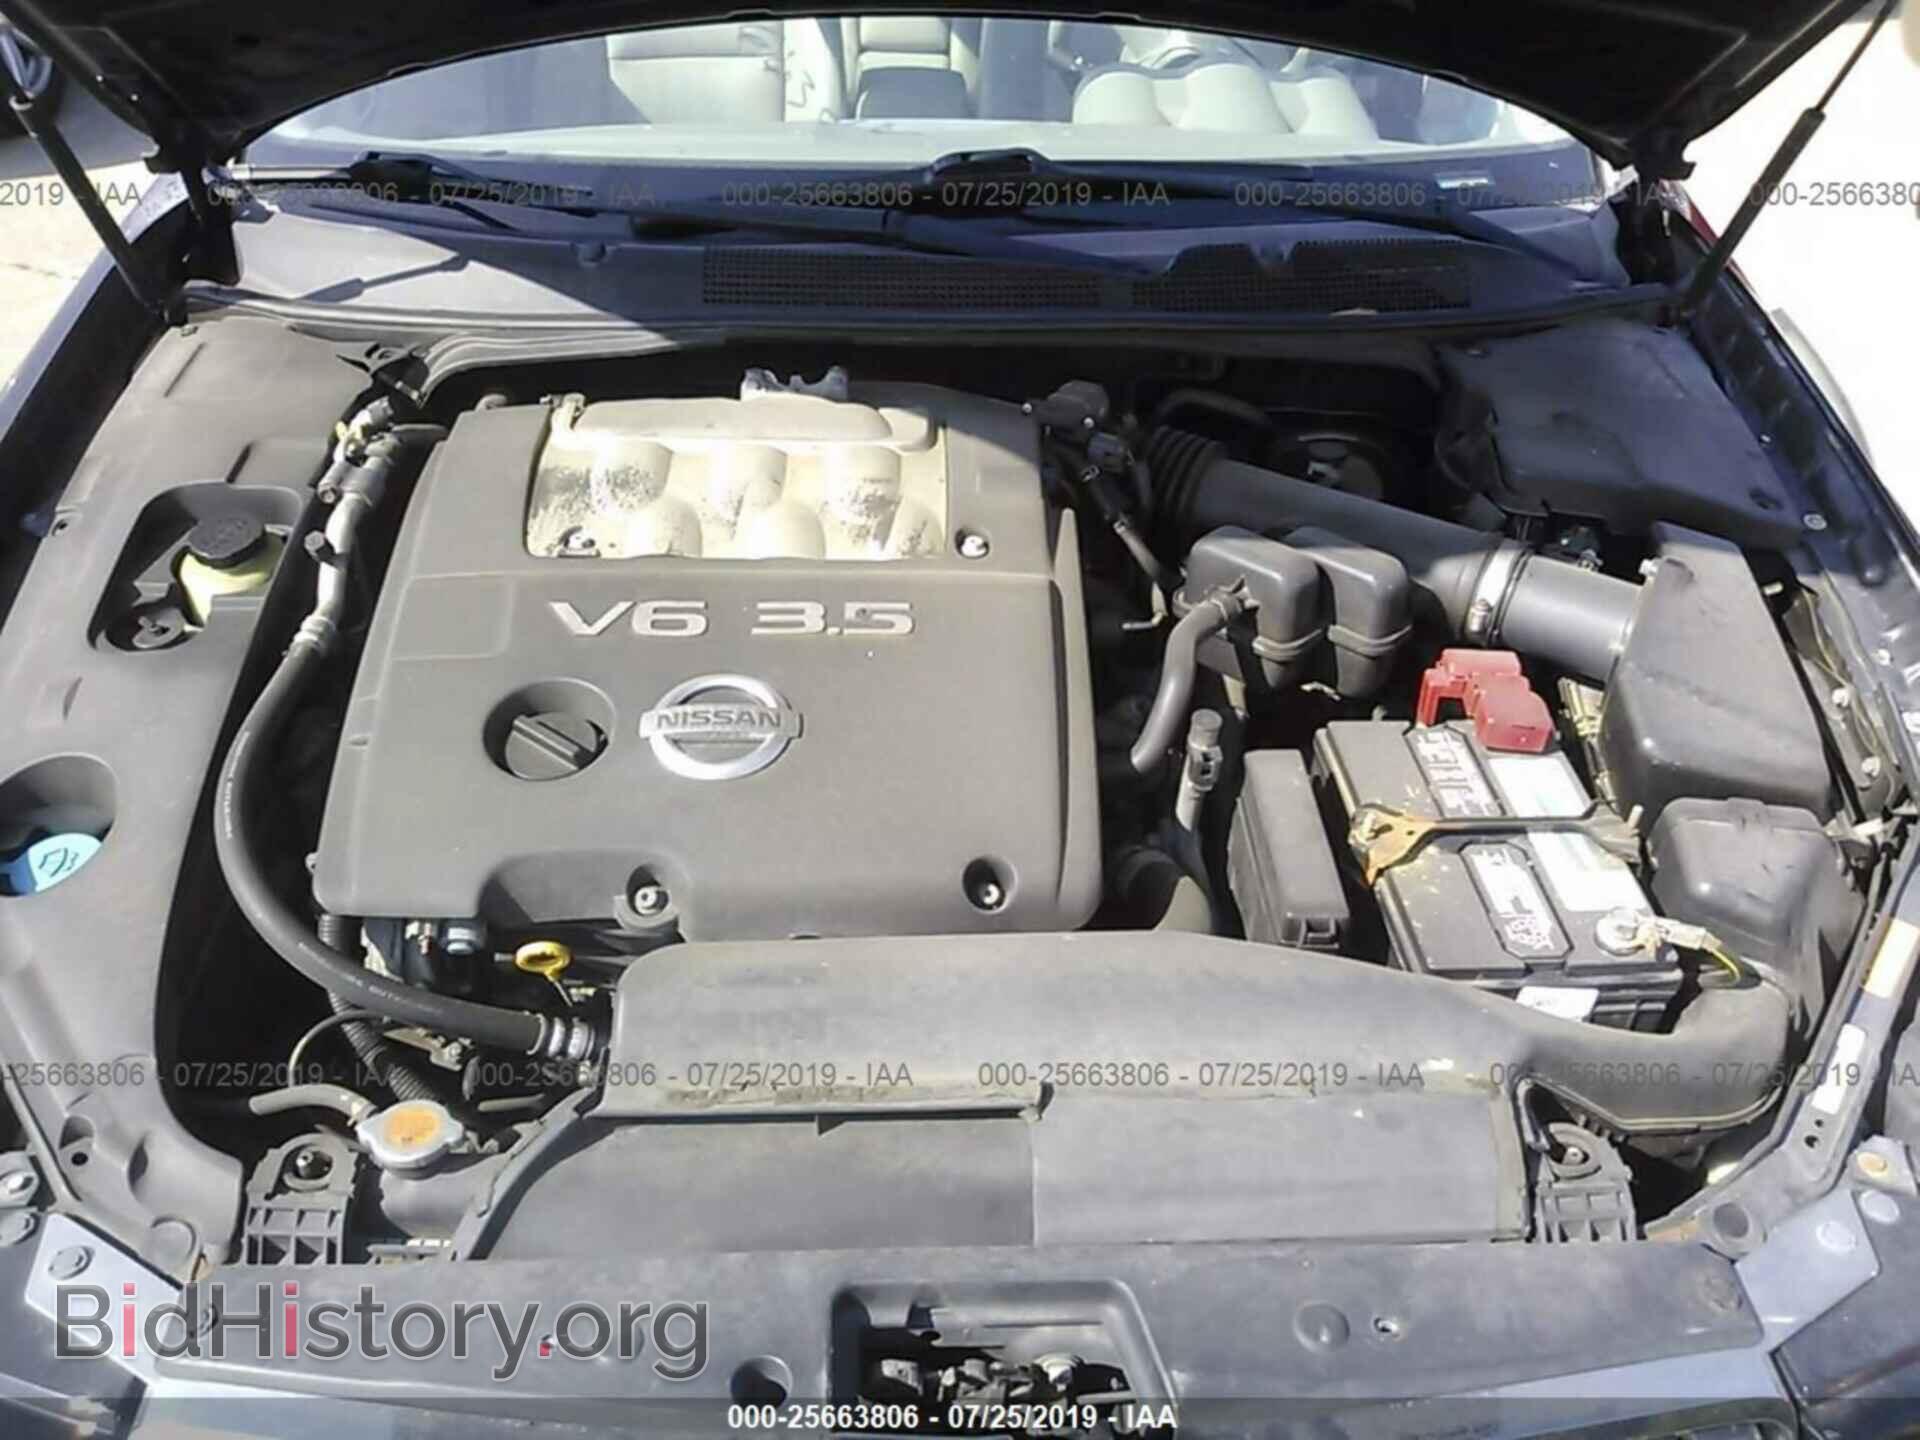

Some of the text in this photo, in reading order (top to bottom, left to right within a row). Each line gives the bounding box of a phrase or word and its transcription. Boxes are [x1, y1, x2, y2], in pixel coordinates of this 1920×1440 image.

[548, 600, 915, 637] V6 3.5
[656, 709, 782, 729] NISSAN
